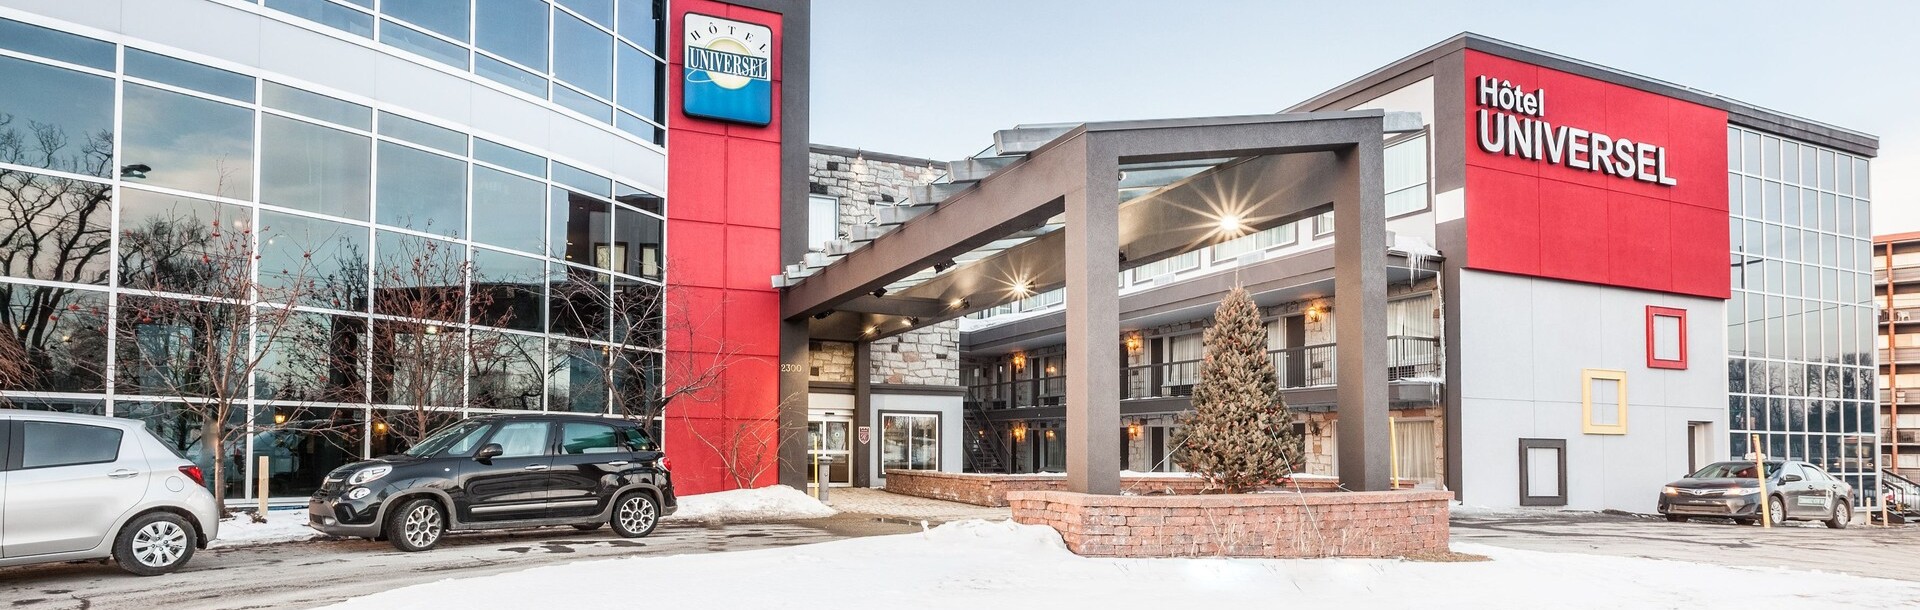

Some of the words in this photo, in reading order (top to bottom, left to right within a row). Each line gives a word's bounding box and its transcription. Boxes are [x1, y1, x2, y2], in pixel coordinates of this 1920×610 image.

[690, 22, 766, 53] HÔTEL
[689, 47, 767, 79] UNIVERSEL
[1477, 75, 1545, 117] Hôtel
[1477, 109, 1677, 186] UNIVERSEL
[780, 363, 802, 373] 2300
